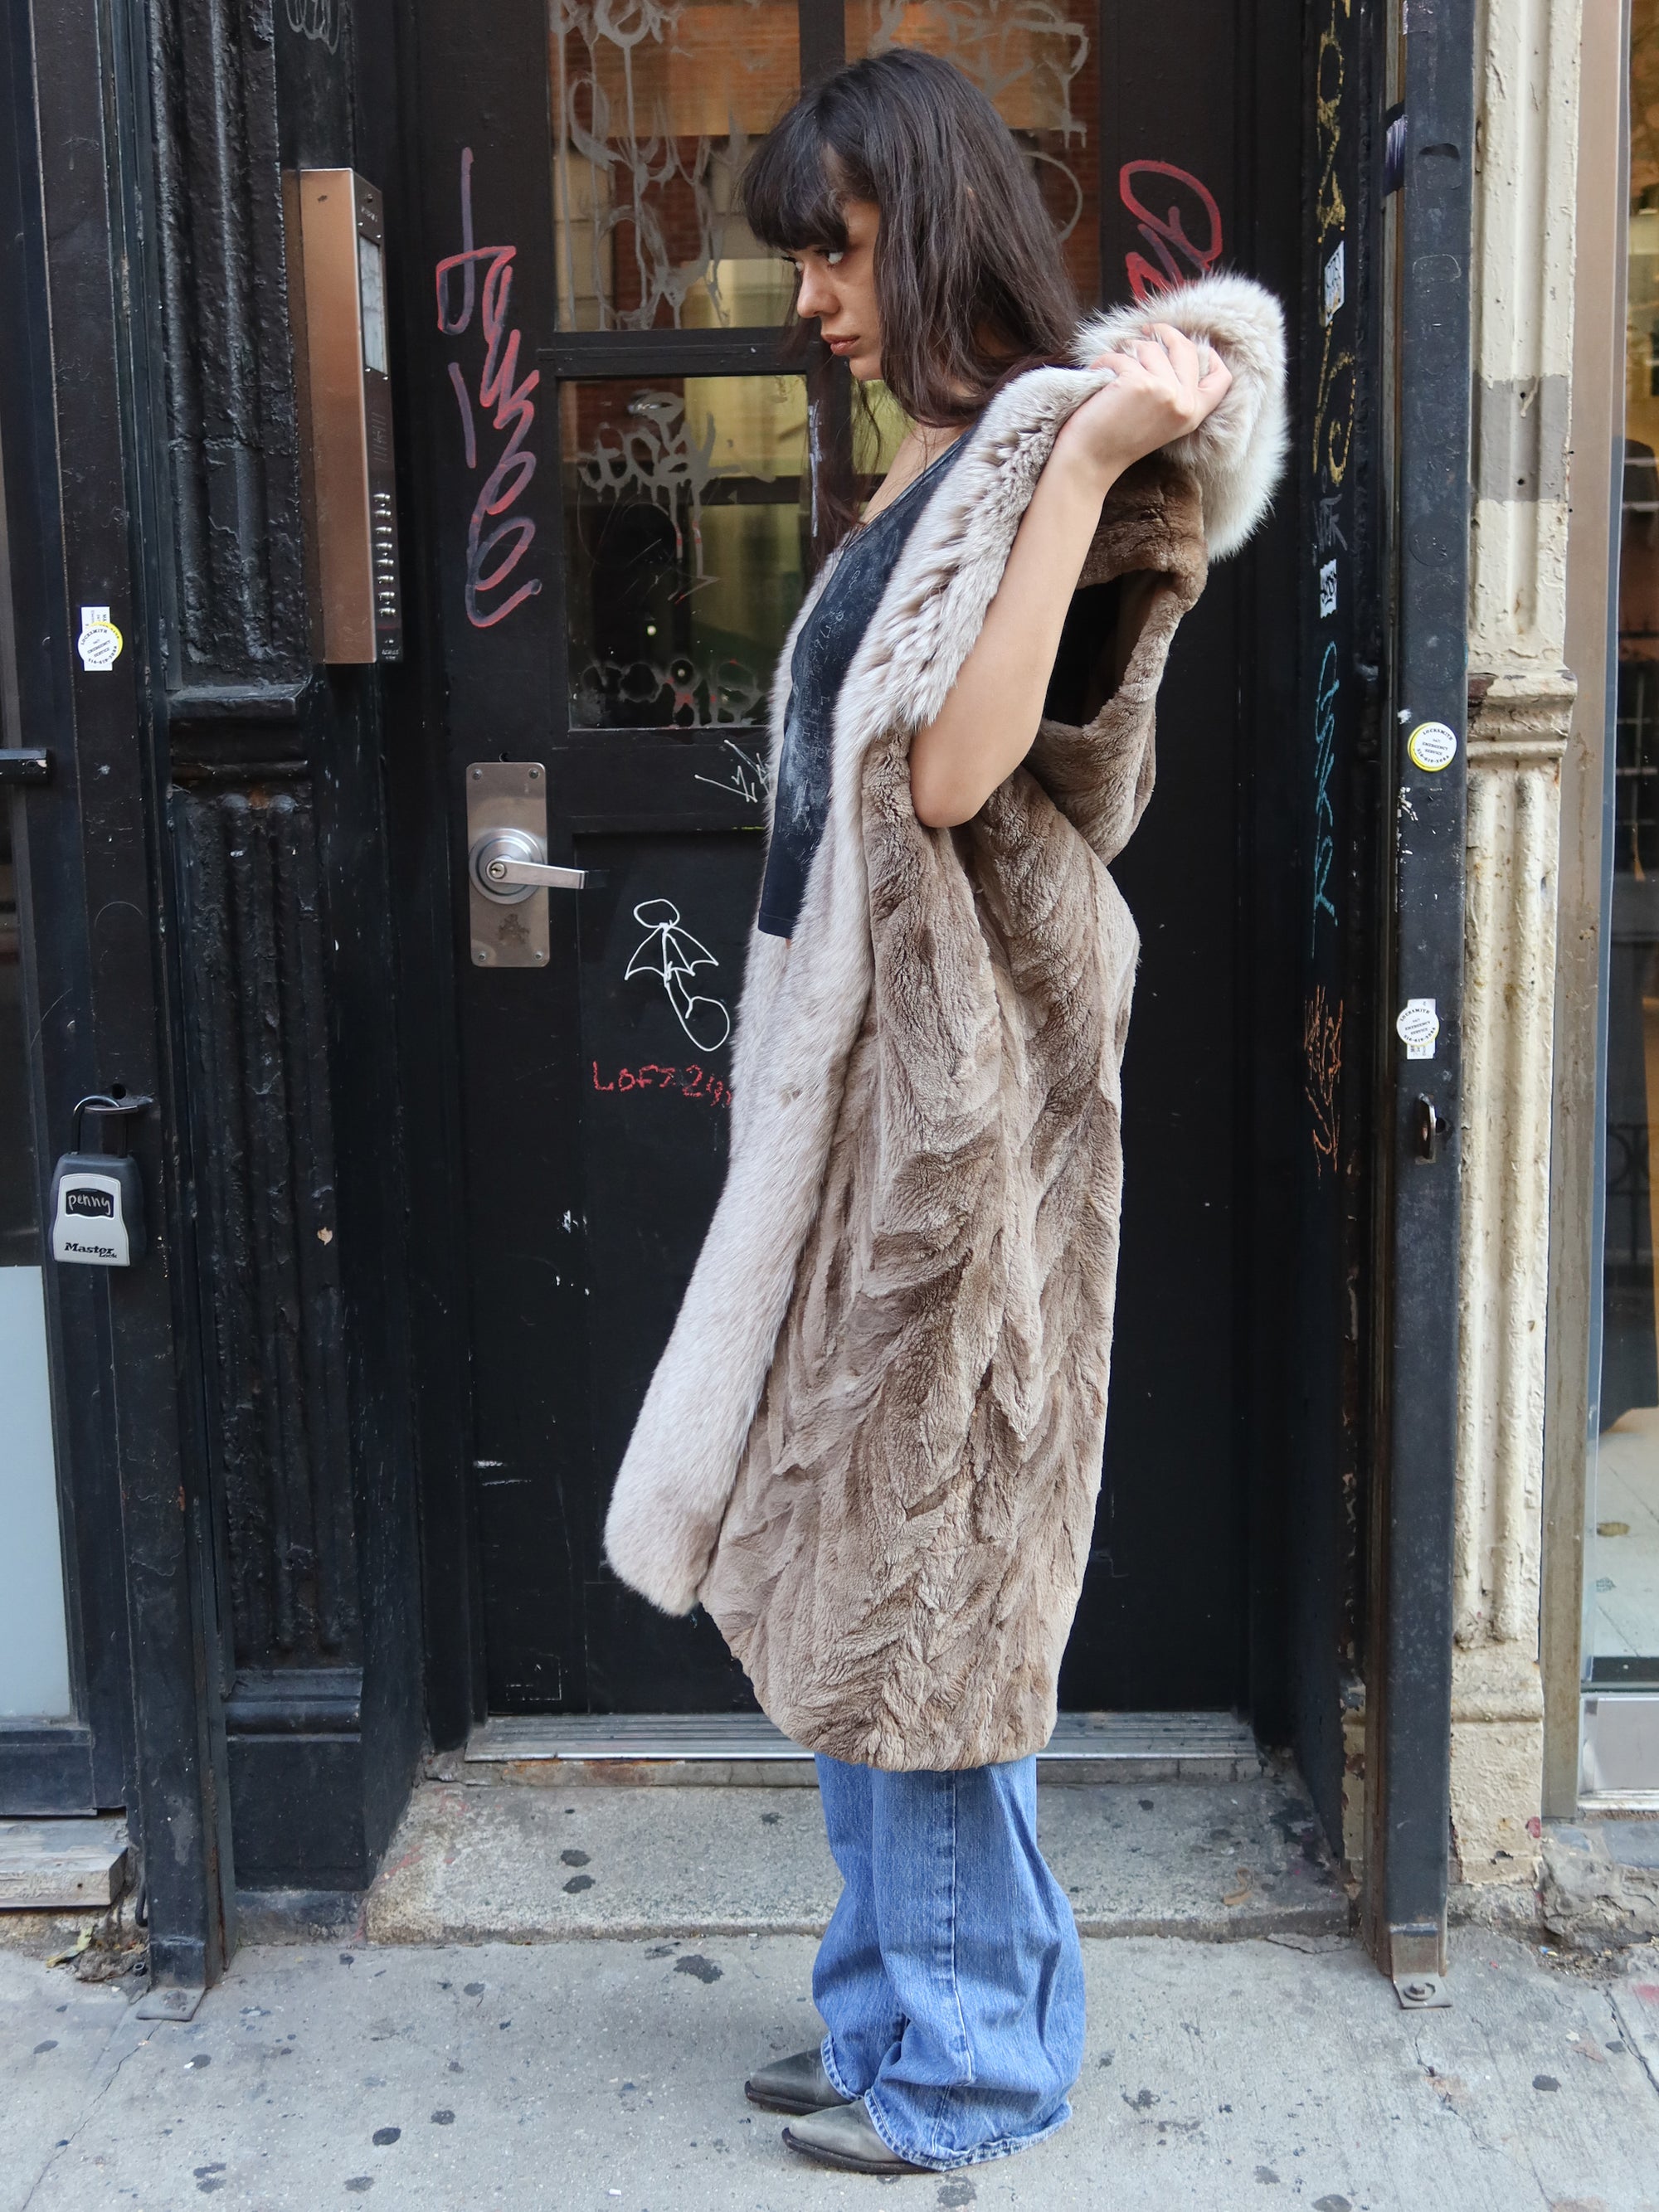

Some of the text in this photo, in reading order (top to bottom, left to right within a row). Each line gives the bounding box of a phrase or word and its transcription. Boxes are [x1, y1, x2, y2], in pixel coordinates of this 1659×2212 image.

[80, 629, 108, 645] LOCKSMITH
[87, 639, 111, 654] EMERGENCY
[94, 647, 110, 658] SERVICE
[1423, 728, 1453, 741] LOCKSMITH
[1422, 741, 1448, 751] EMERGENCY
[1399, 1008, 1430, 1022] LOCKSMITH
[1404, 1020, 1431, 1031] EMERGENCY
[67, 1194, 111, 1216] penny
[64, 1242, 115, 1255] Master
